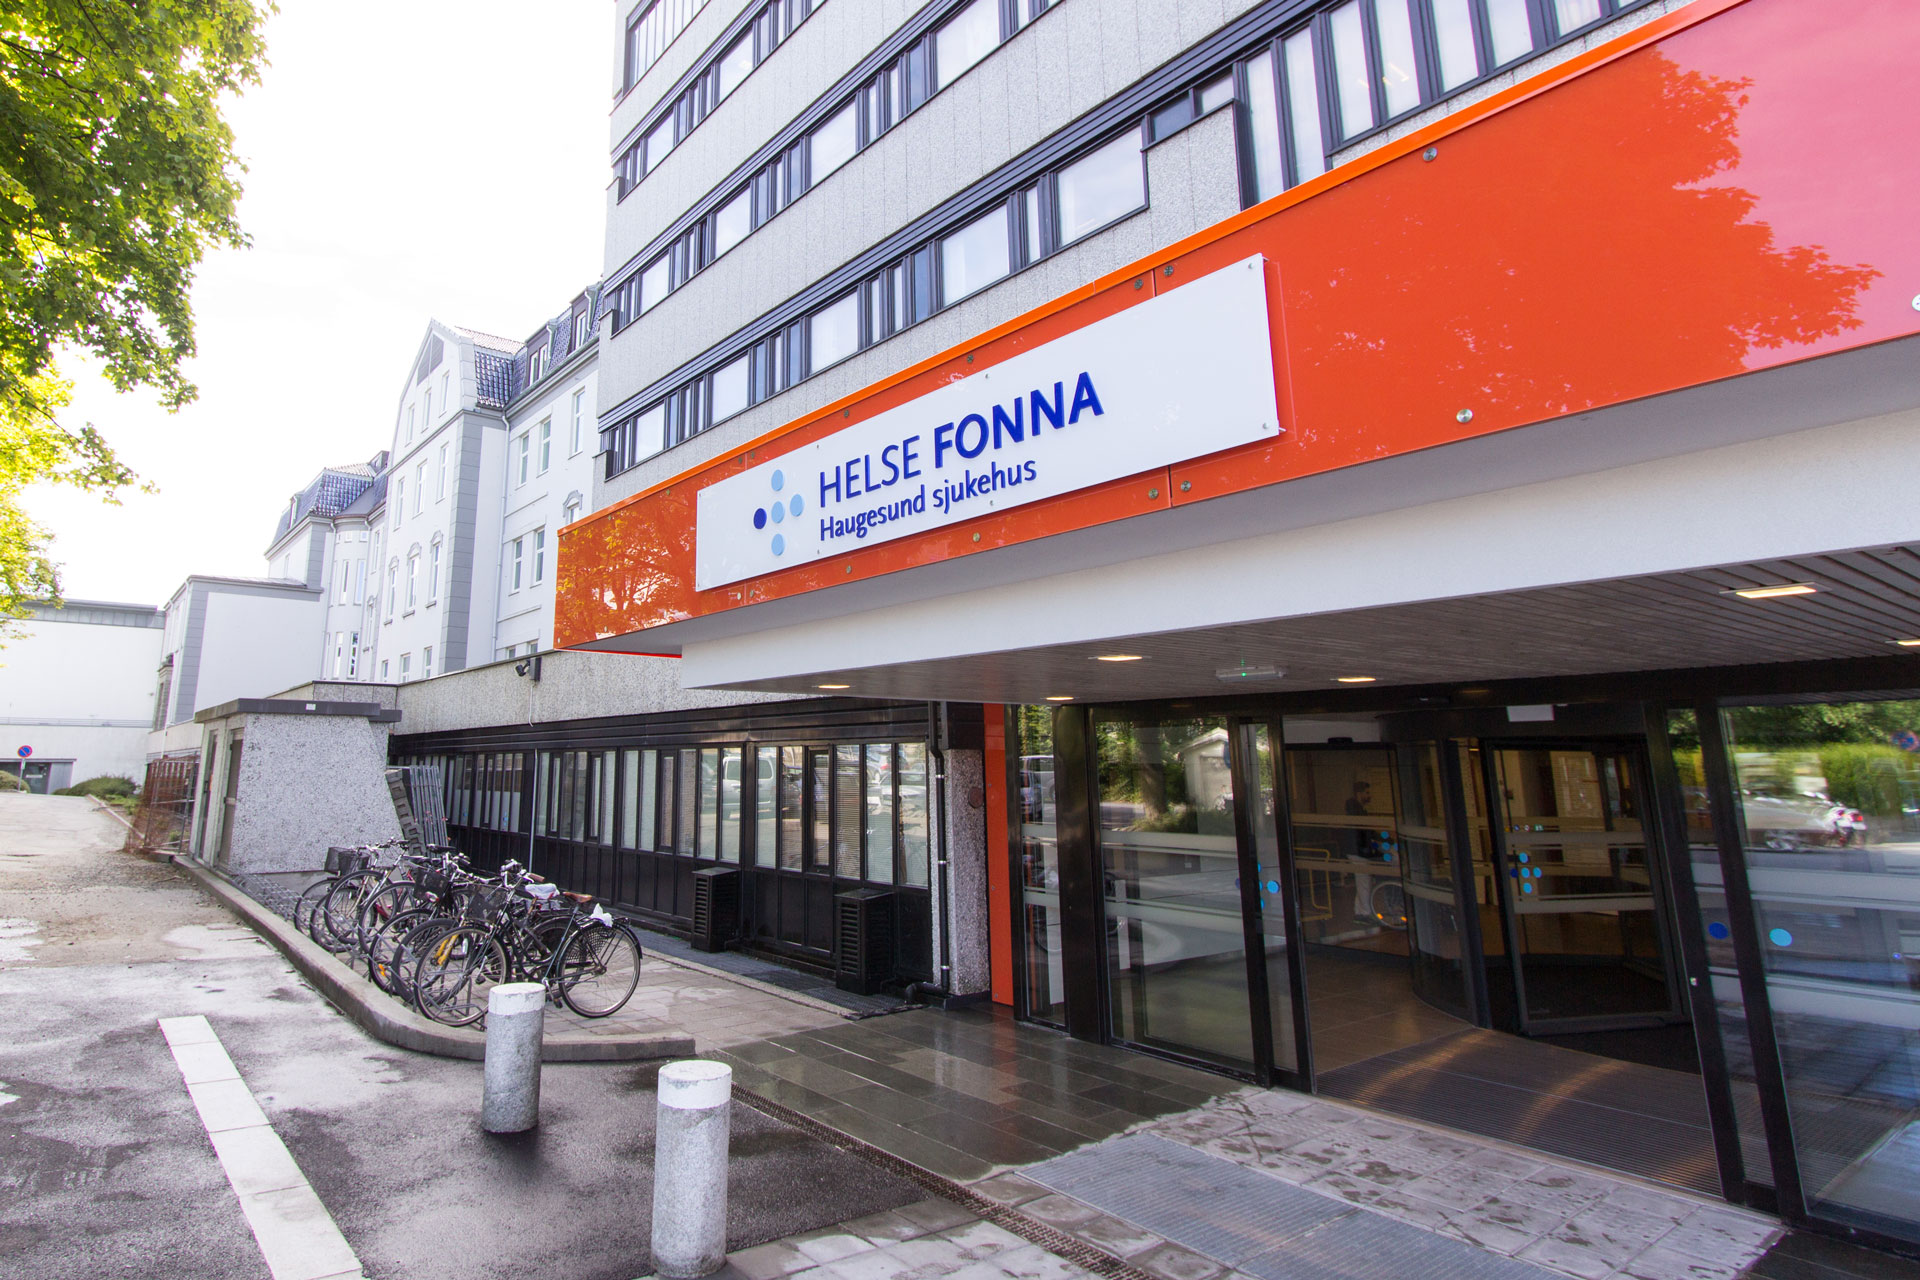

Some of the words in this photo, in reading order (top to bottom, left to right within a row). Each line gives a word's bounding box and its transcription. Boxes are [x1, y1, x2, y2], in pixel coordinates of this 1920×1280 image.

[819, 435, 922, 508] HELSE
[934, 371, 1106, 469] FONNA
[819, 484, 926, 542] Haugesund
[932, 460, 1037, 515] sjukehus
